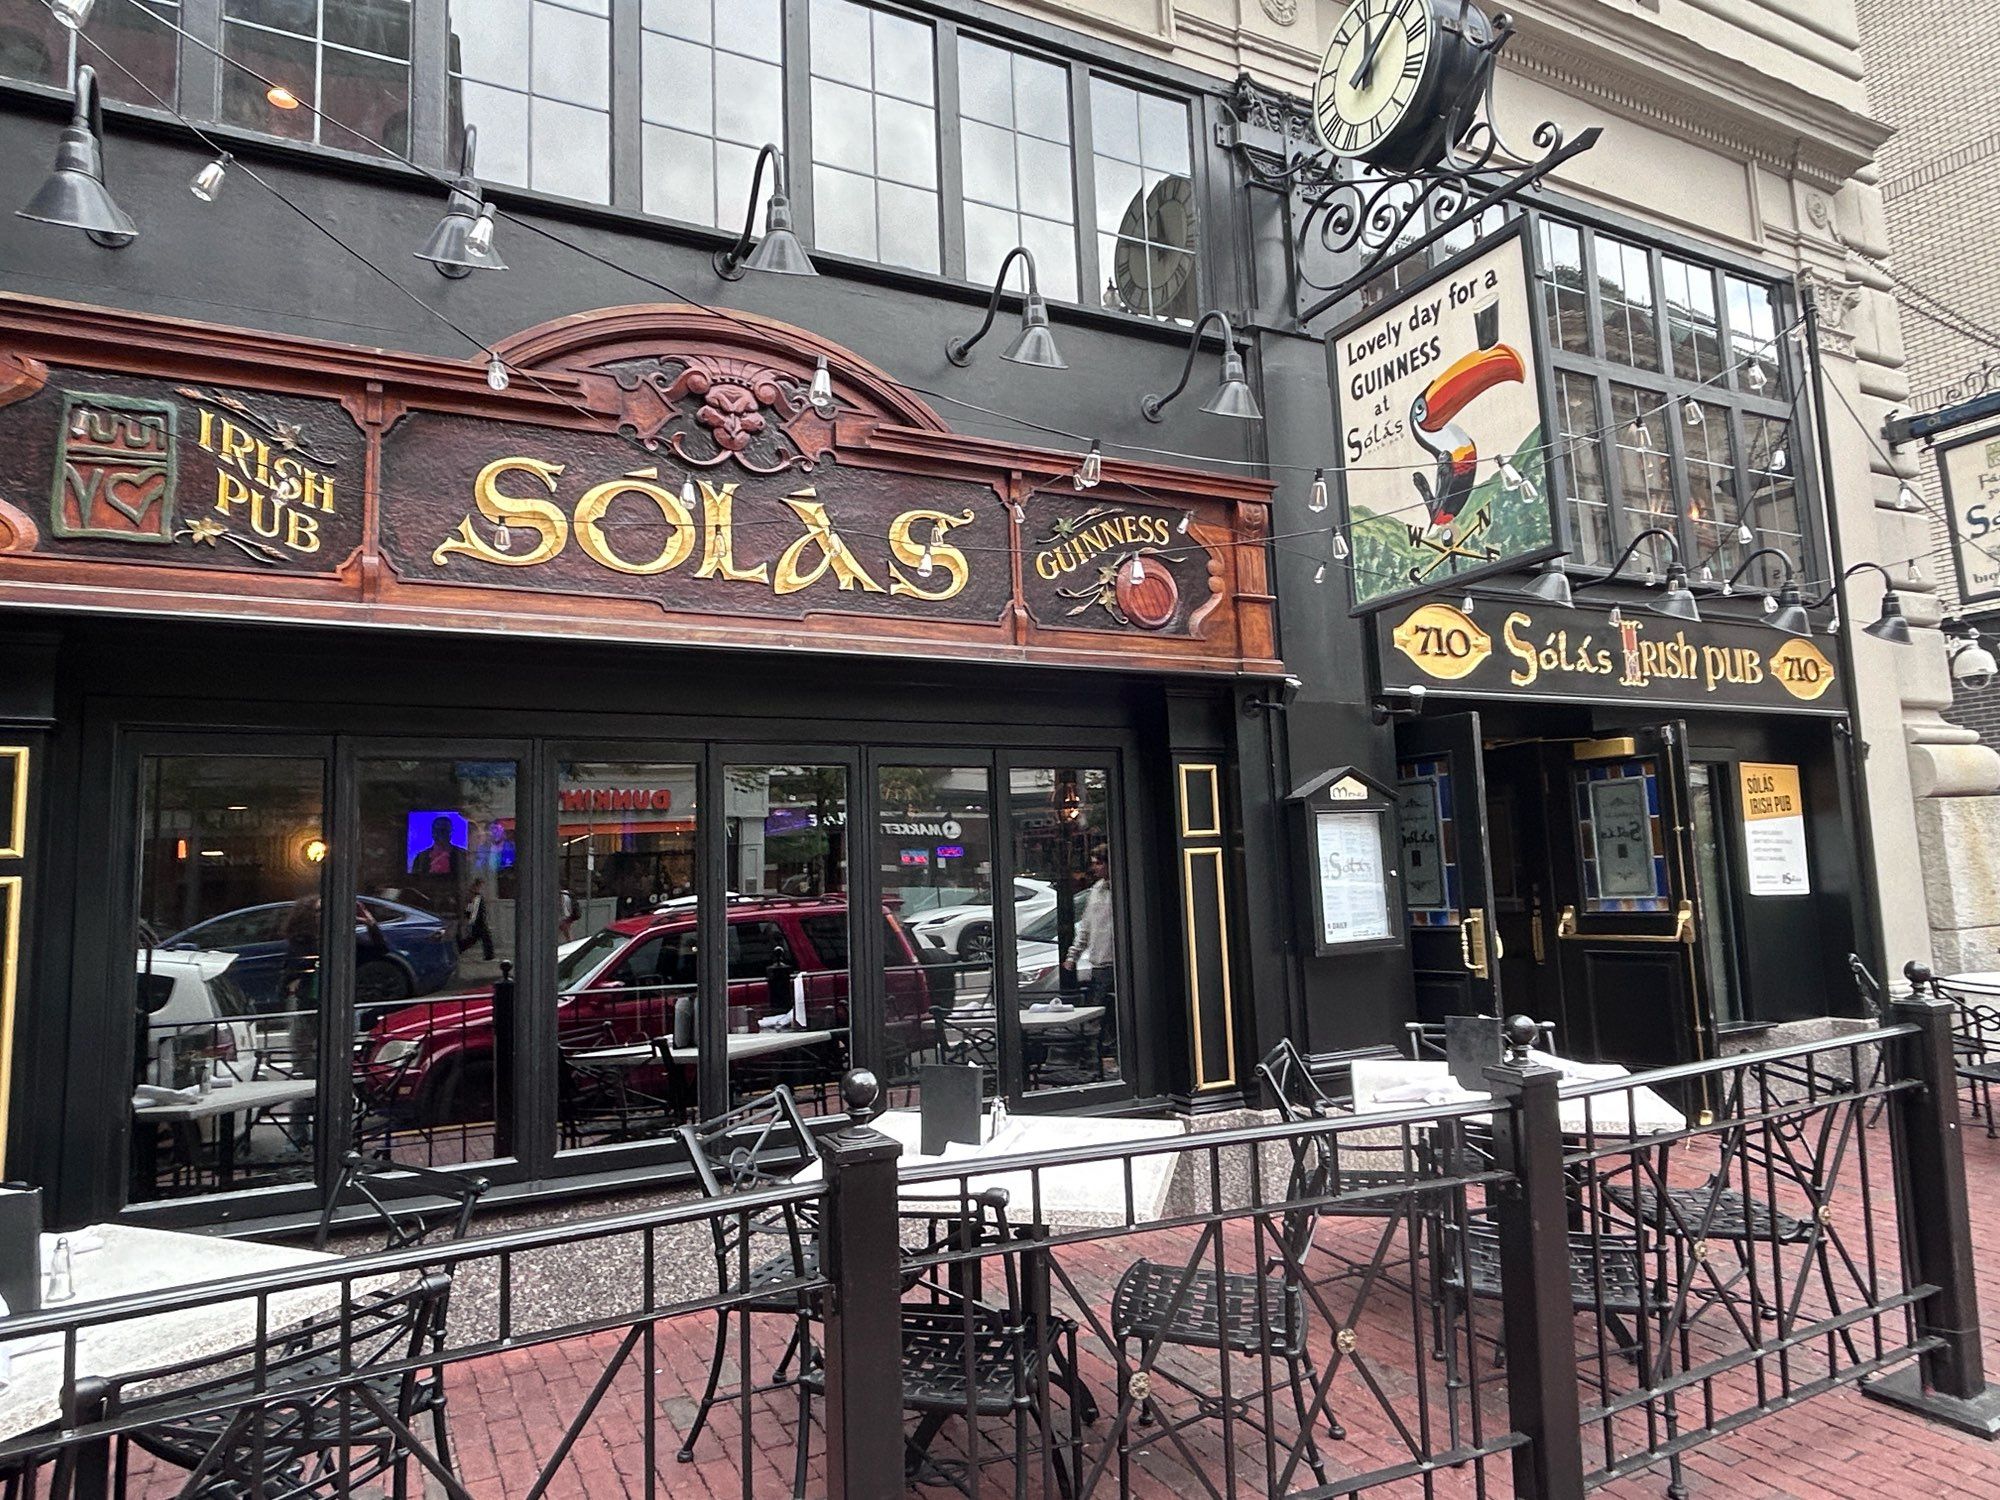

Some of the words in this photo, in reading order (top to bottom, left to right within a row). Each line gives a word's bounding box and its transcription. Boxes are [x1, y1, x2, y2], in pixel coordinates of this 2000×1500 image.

[1347, 321, 1402, 366] Lovely
[1408, 298, 1442, 332] day
[1448, 278, 1478, 309] for
[1484, 269, 1498, 289] a
[1350, 335, 1441, 401] GUINNESS
[1374, 395, 1390, 416] at
[198, 407, 336, 514] IRISH
[214, 467, 321, 554] PUB
[1034, 514, 1170, 581] GUINNESS
[1414, 624, 1472, 658] 710
[1503, 611, 1614, 687] Sólás
[1783, 655, 1821, 683] 710
[1749, 796, 1774, 815] IRISH
[1774, 794, 1792, 813] PUB
